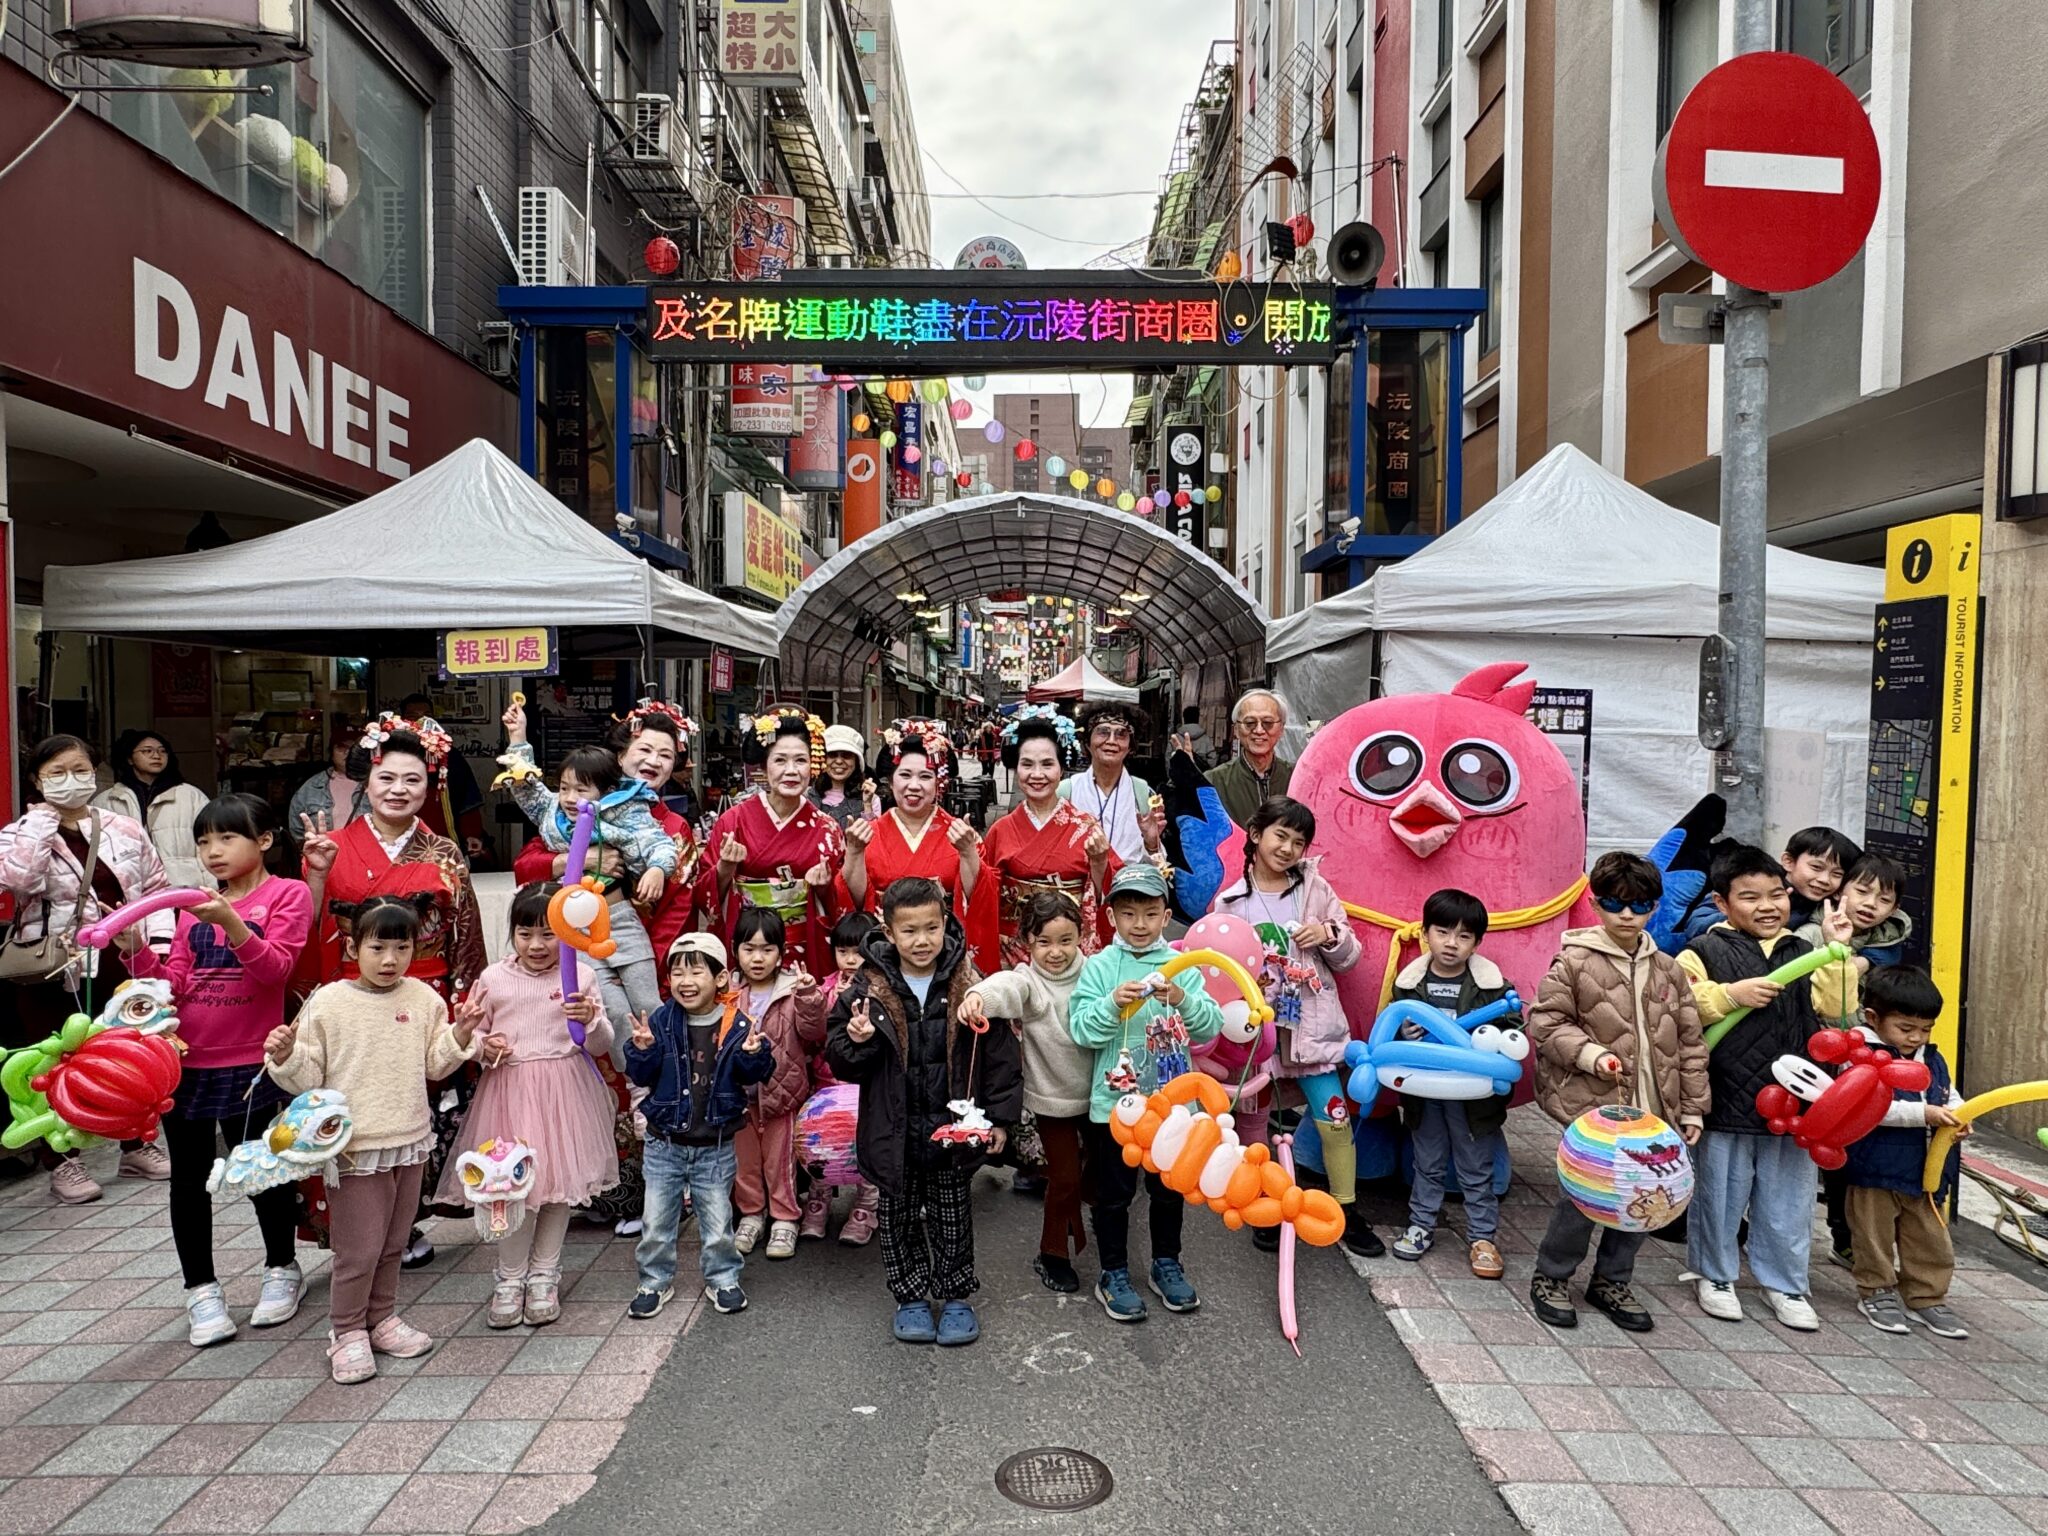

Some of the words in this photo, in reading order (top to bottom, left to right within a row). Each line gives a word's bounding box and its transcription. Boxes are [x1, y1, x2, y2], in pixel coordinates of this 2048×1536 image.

[133, 256, 411, 481] DANEE
[554, 389, 581, 496] 沅陵商圈
[733, 420, 792, 431] 02-2331-0956
[1386, 391, 1412, 500] 沅陵商圈
[1177, 472, 1193, 516] SIA
[454, 636, 541, 666] 報到處
[1956, 596, 1968, 648] TOURIST
[1950, 651, 1966, 734] INFORMATION
